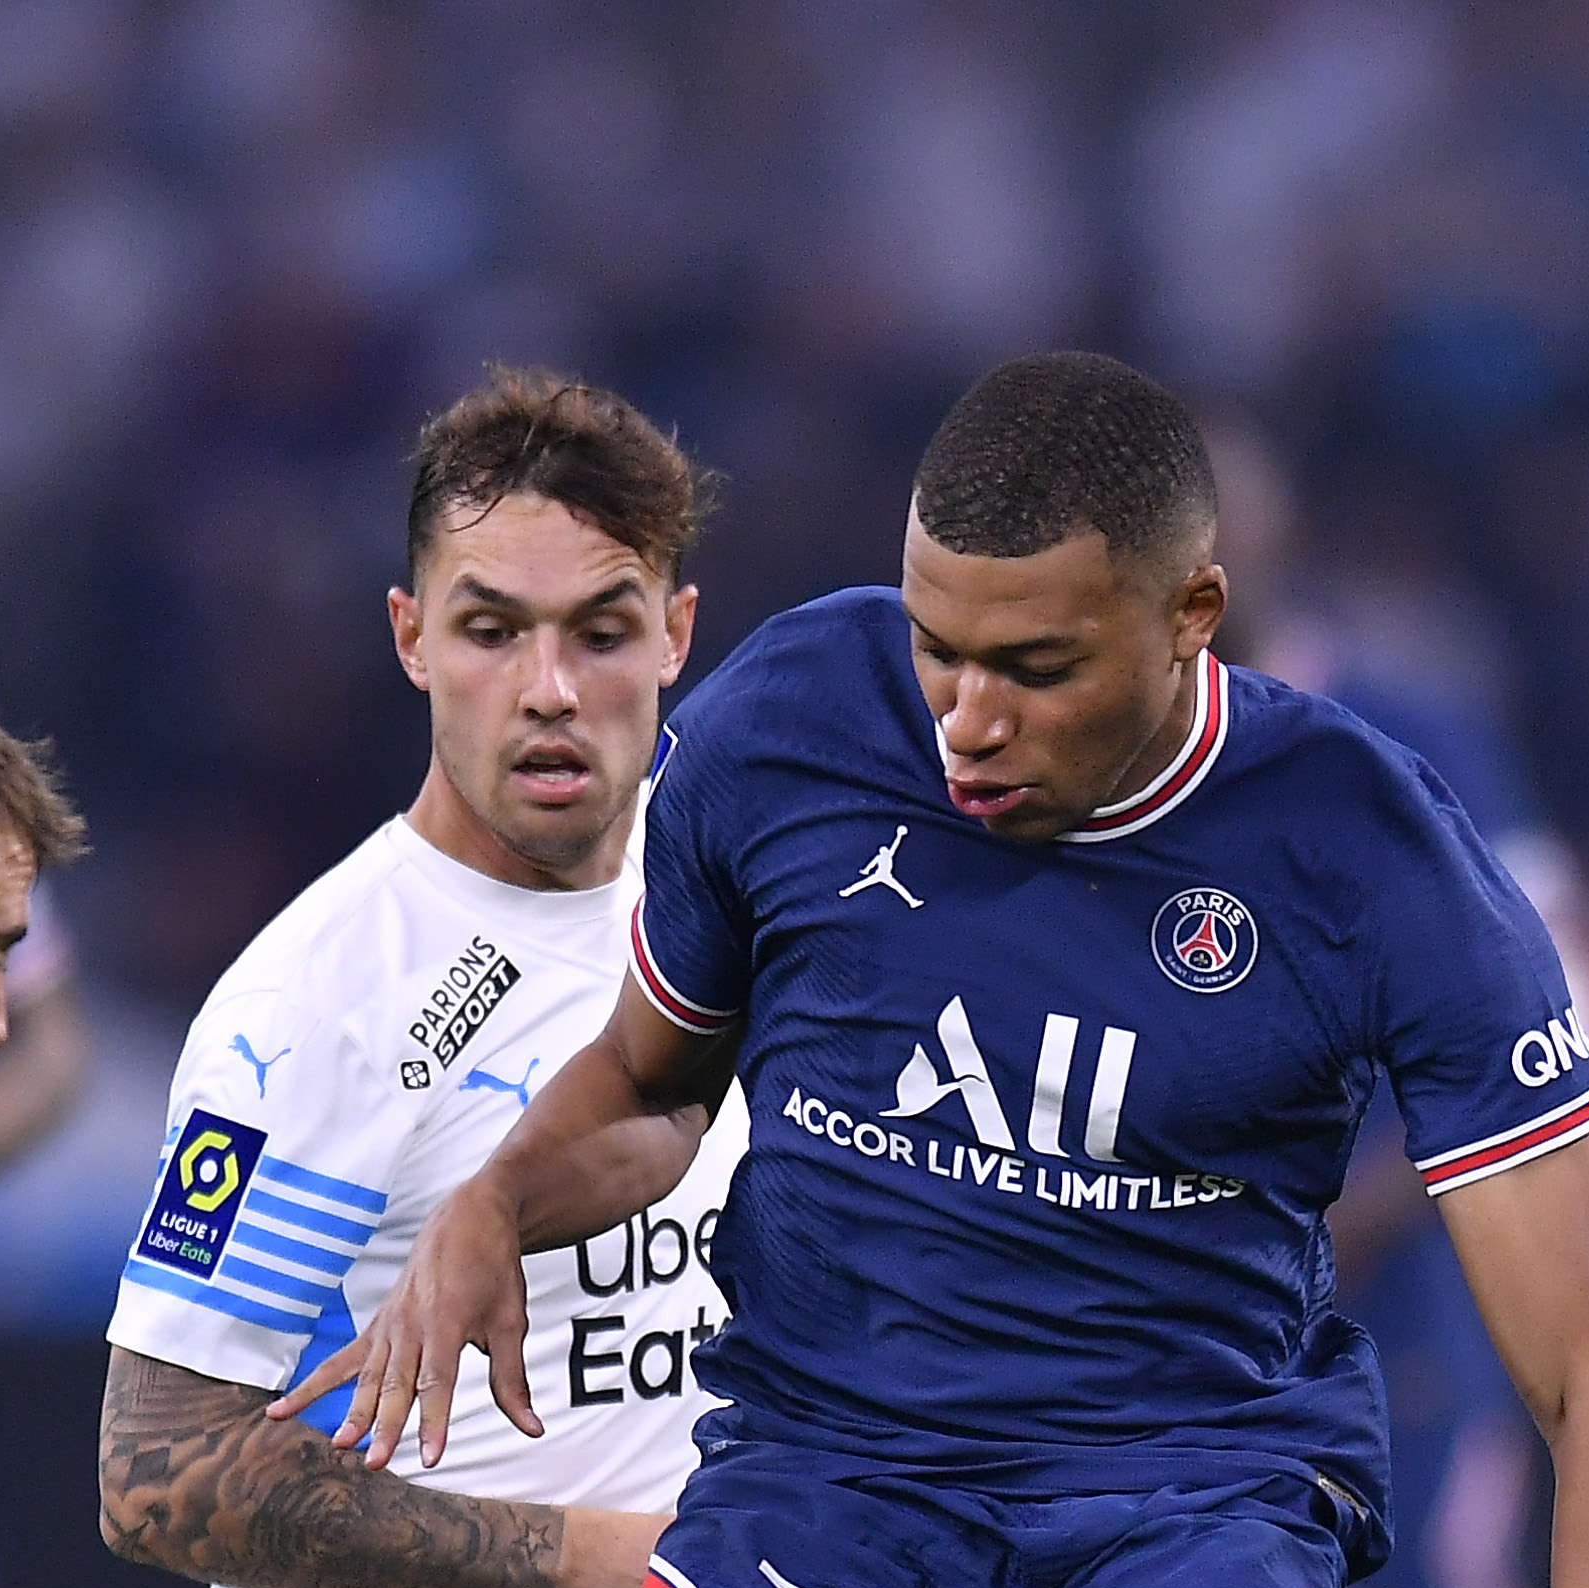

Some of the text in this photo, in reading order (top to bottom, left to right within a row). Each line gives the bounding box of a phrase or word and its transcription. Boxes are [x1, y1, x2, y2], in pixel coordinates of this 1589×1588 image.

[1177, 893, 1245, 926] PARIS
[409, 935, 496, 1048] PARIONS
[438, 959, 510, 1066] SPORT
[782, 1087, 1247, 1210] ACCOR LIVE LIMITLESS
[147, 1229, 212, 1265] Uber Eats
[160, 1211, 218, 1244] LIGUE 1
[576, 1208, 721, 1298] Ube
